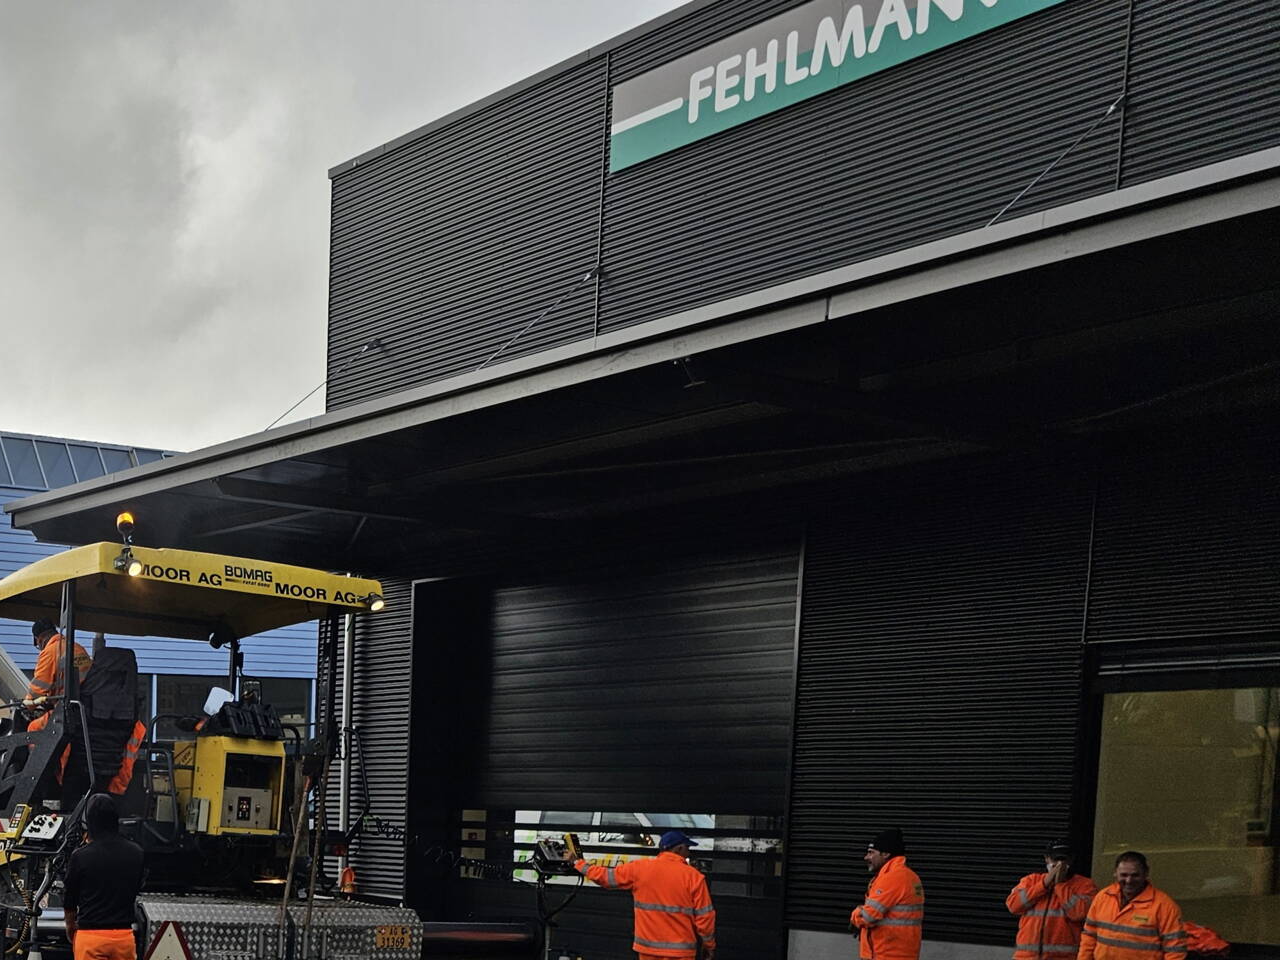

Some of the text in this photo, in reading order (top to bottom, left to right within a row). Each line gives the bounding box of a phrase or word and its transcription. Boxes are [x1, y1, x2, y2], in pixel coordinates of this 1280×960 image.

[198, 572, 223, 587] AG
[224, 565, 273, 583] BOMAG
[275, 583, 327, 600] MOOR
[333, 591, 356, 604] AG
[380, 936, 405, 948] 31369
